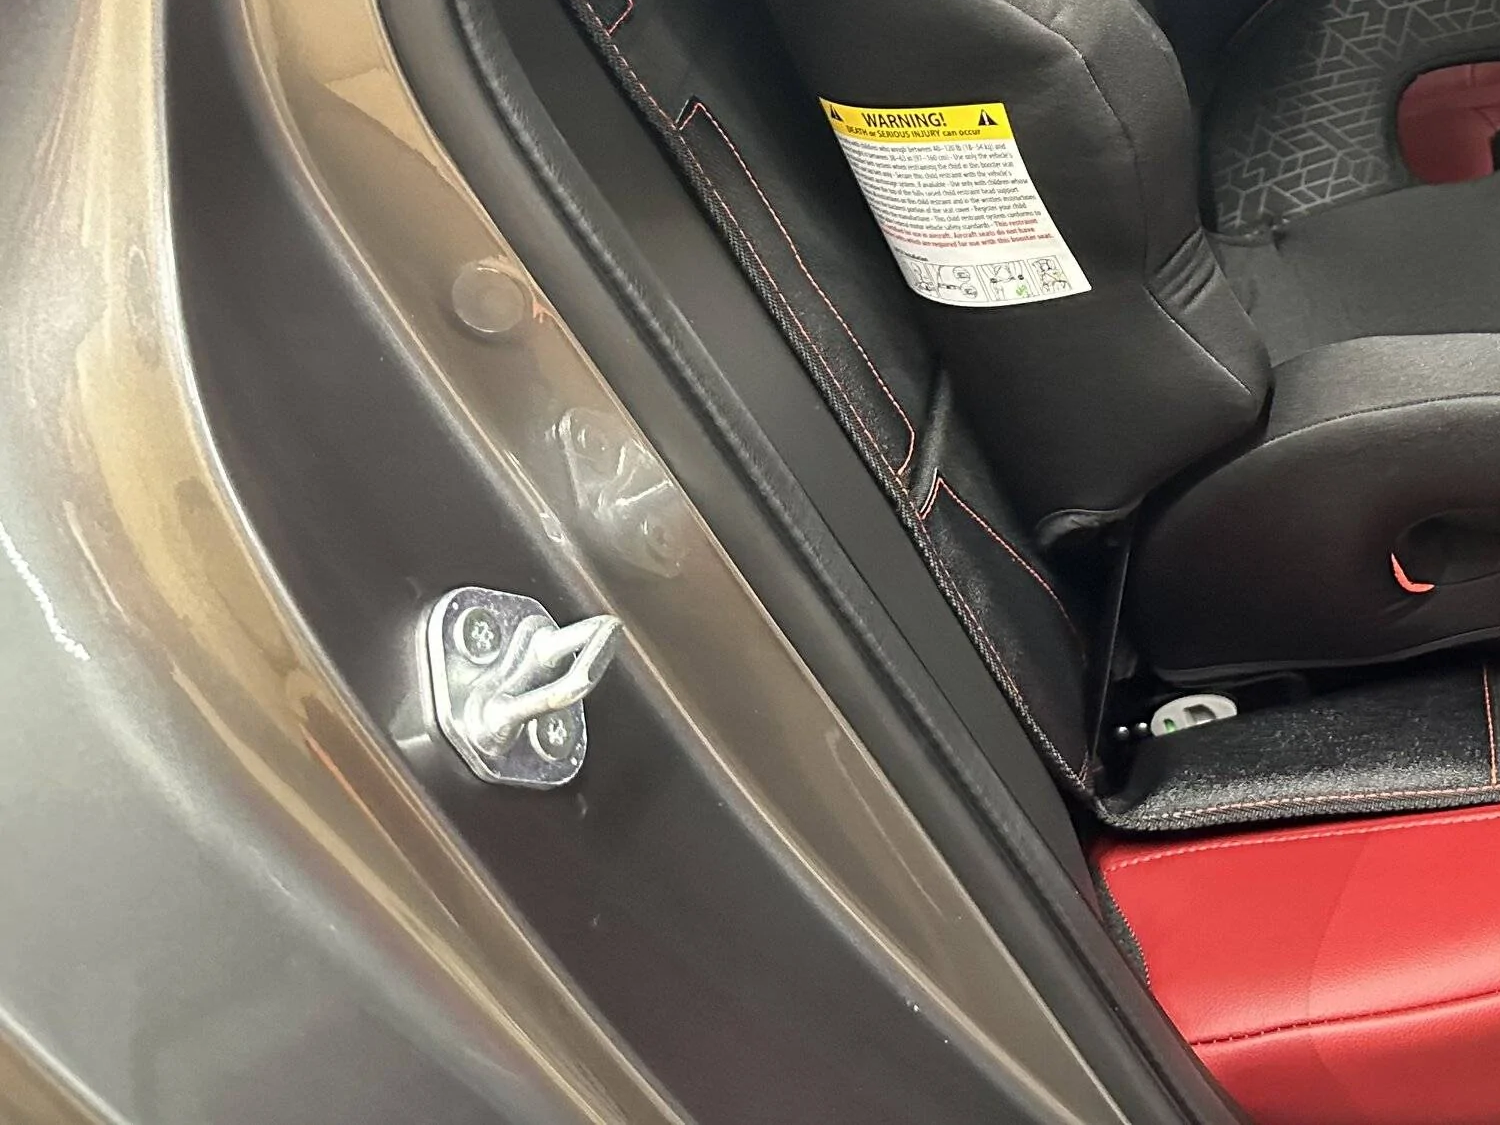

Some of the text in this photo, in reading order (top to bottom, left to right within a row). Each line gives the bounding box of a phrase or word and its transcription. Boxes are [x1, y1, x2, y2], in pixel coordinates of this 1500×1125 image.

[861, 112, 947, 129] WARNING!
[846, 124, 867, 136] DEATH
[877, 130, 911, 139] SERIOUS
[912, 129, 941, 138] INJURY
